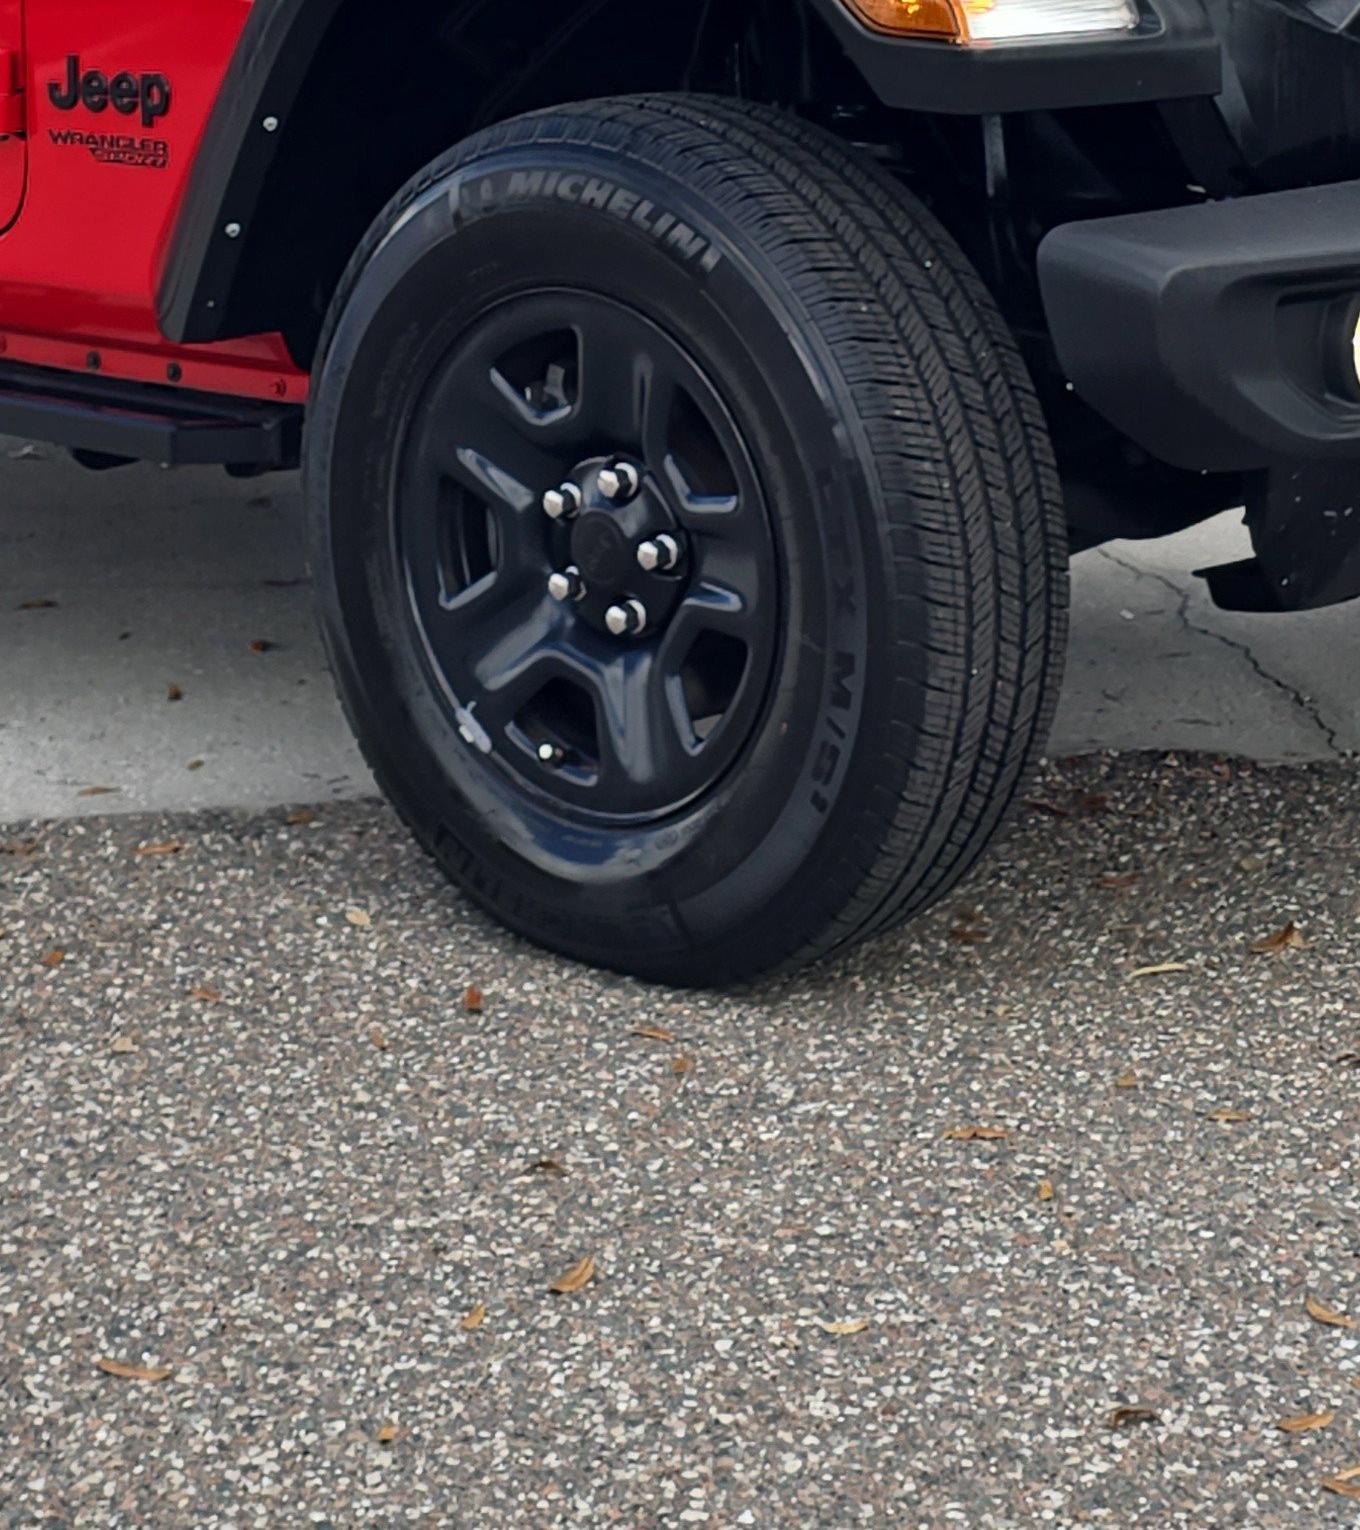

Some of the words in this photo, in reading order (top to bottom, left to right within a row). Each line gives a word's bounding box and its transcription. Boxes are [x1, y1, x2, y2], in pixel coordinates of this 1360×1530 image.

[48, 54, 170, 128] Jeep
[48, 127, 169, 153] WRANGLER
[506, 168, 711, 262] MICHELIN
